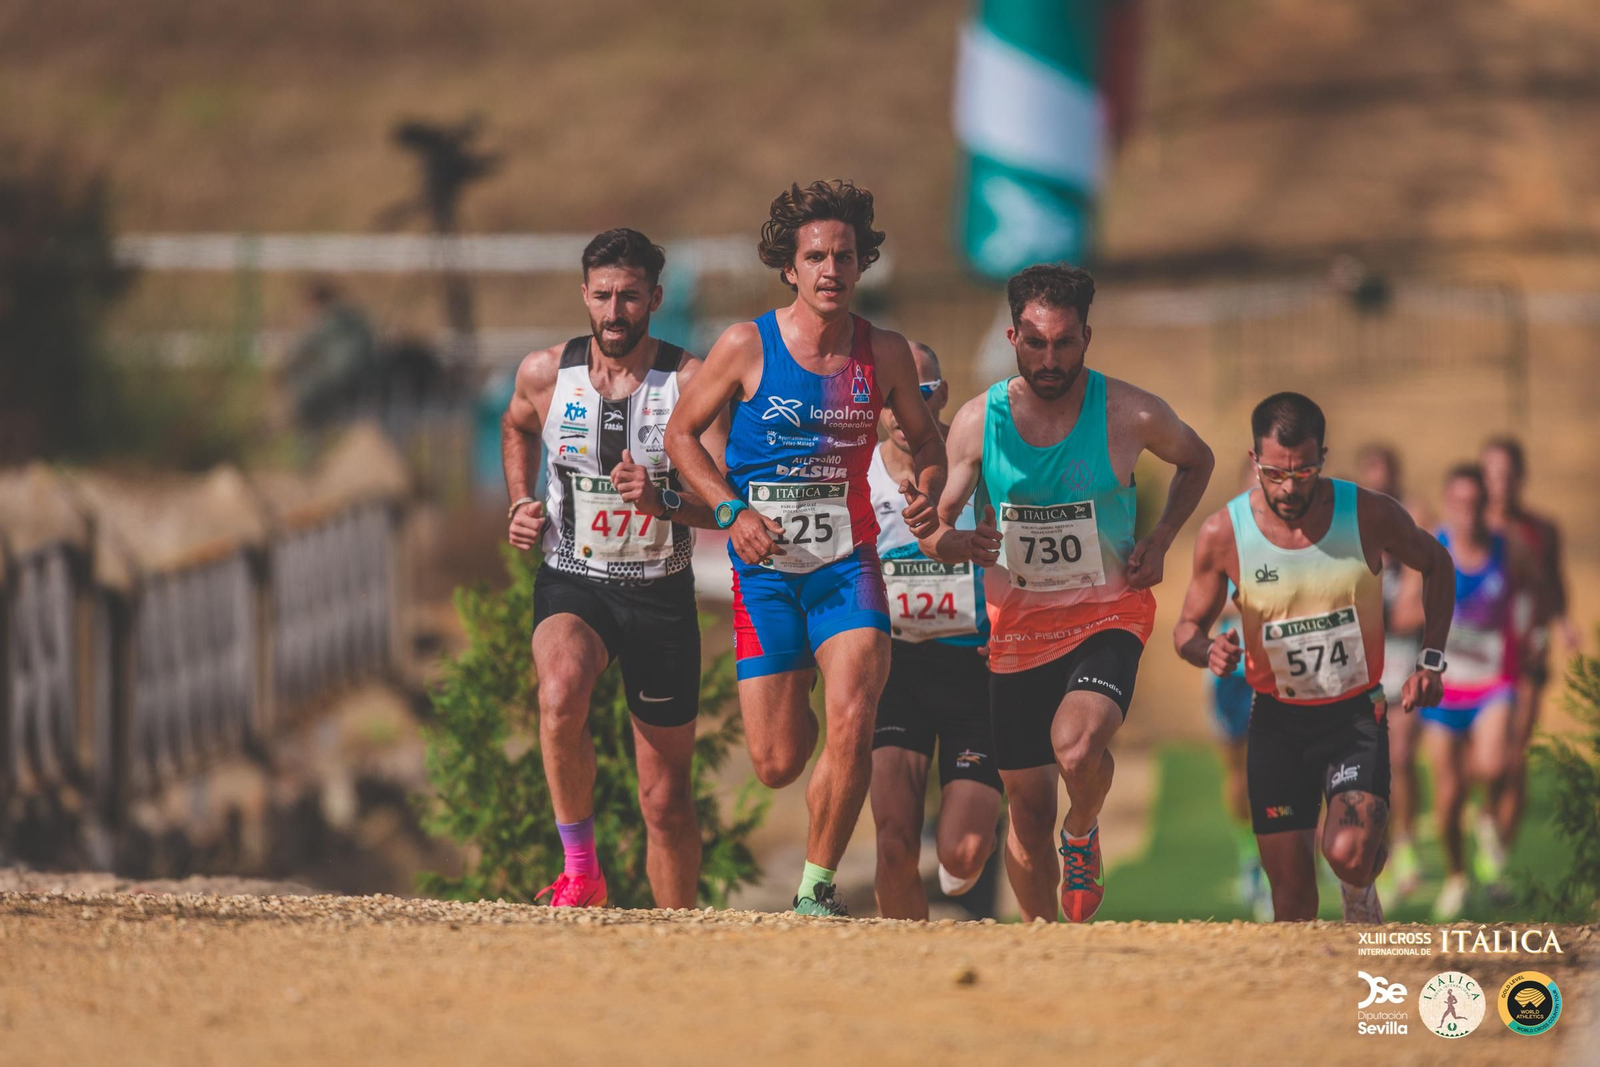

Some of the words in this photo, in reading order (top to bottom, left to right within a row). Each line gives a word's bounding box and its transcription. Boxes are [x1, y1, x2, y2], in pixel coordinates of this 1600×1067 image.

[810, 405, 874, 425] lapalma
[776, 486, 821, 499] ITÁLICA
[591, 510, 653, 537] 477
[1023, 509, 1068, 520] ITÁLICA
[772, 512, 833, 545] 125
[1019, 534, 1082, 564] 730
[900, 561, 946, 574] ITÁLICA
[897, 592, 957, 620] 124
[1288, 618, 1333, 635] ITÁLICA
[1286, 640, 1349, 676] 574
